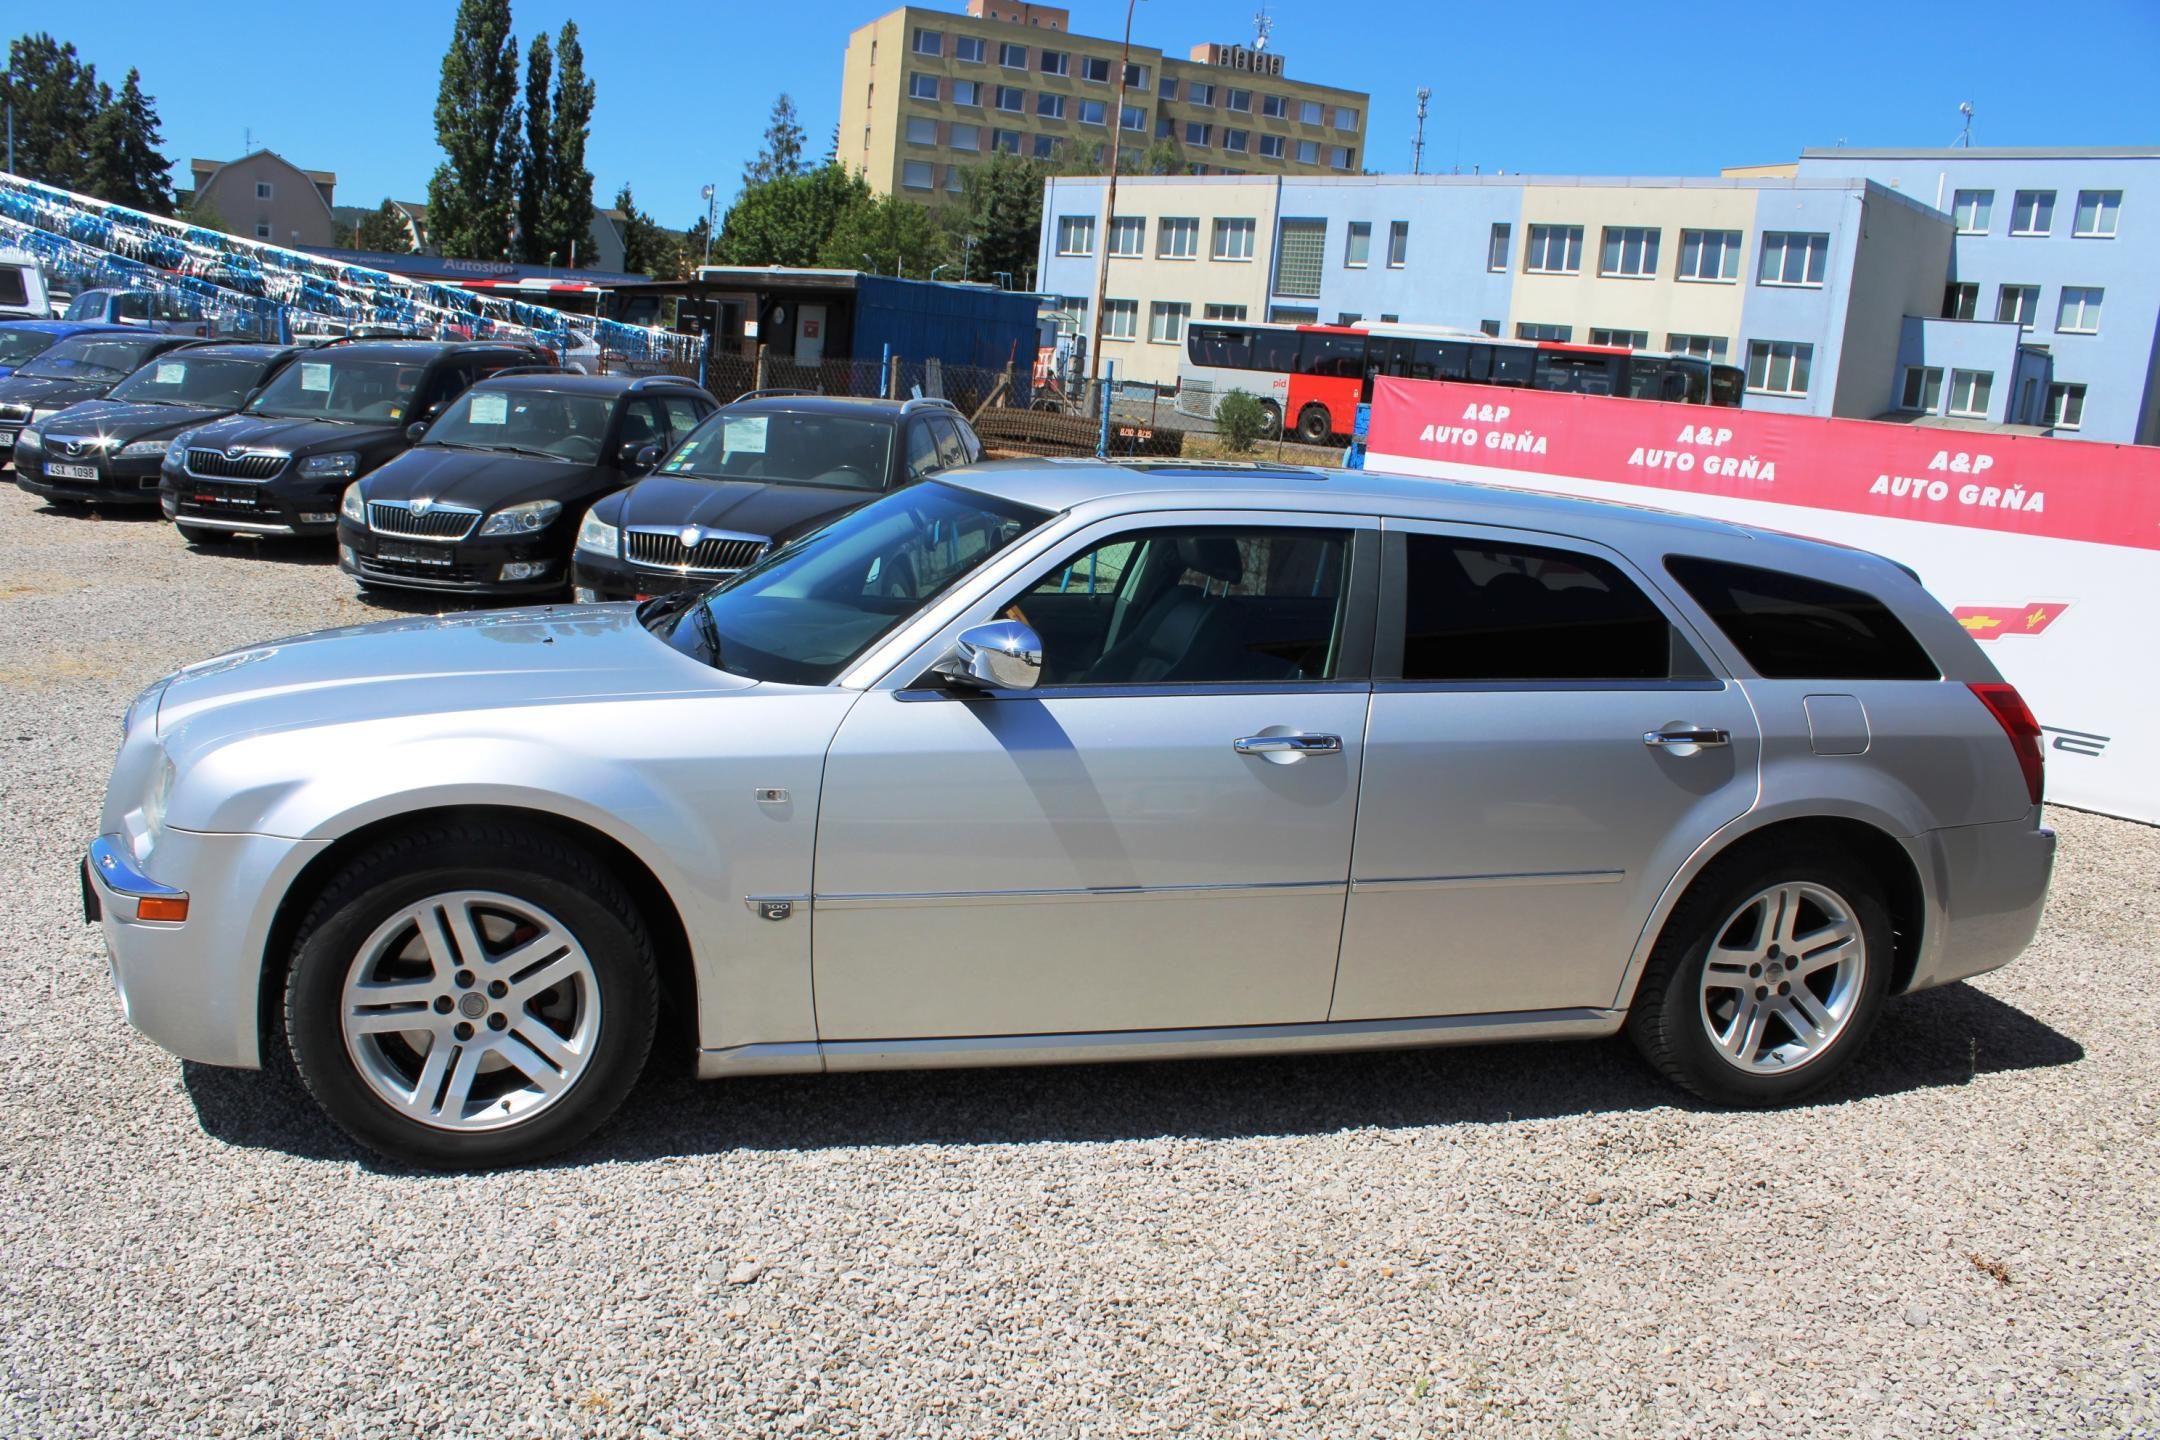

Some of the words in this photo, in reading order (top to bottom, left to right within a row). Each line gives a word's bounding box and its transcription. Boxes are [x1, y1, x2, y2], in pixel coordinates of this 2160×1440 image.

[442, 259, 514, 274] Autosklo
[1273, 378, 1287, 389] pid
[1462, 403, 1511, 423] A&P
[1419, 424, 1478, 446] AUTO
[1484, 430, 1547, 455] GRŇA
[1676, 424, 1733, 447] A&P
[50, 465, 65, 476] 4SX
[72, 467, 95, 478] 1098
[1627, 447, 1695, 472] AUTO
[1703, 455, 1775, 481] GRŇA
[1927, 450, 1994, 475] A&P
[1869, 474, 1949, 502] AUTO
[1958, 483, 2044, 513] GRŇA
[768, 910, 783, 918] C
